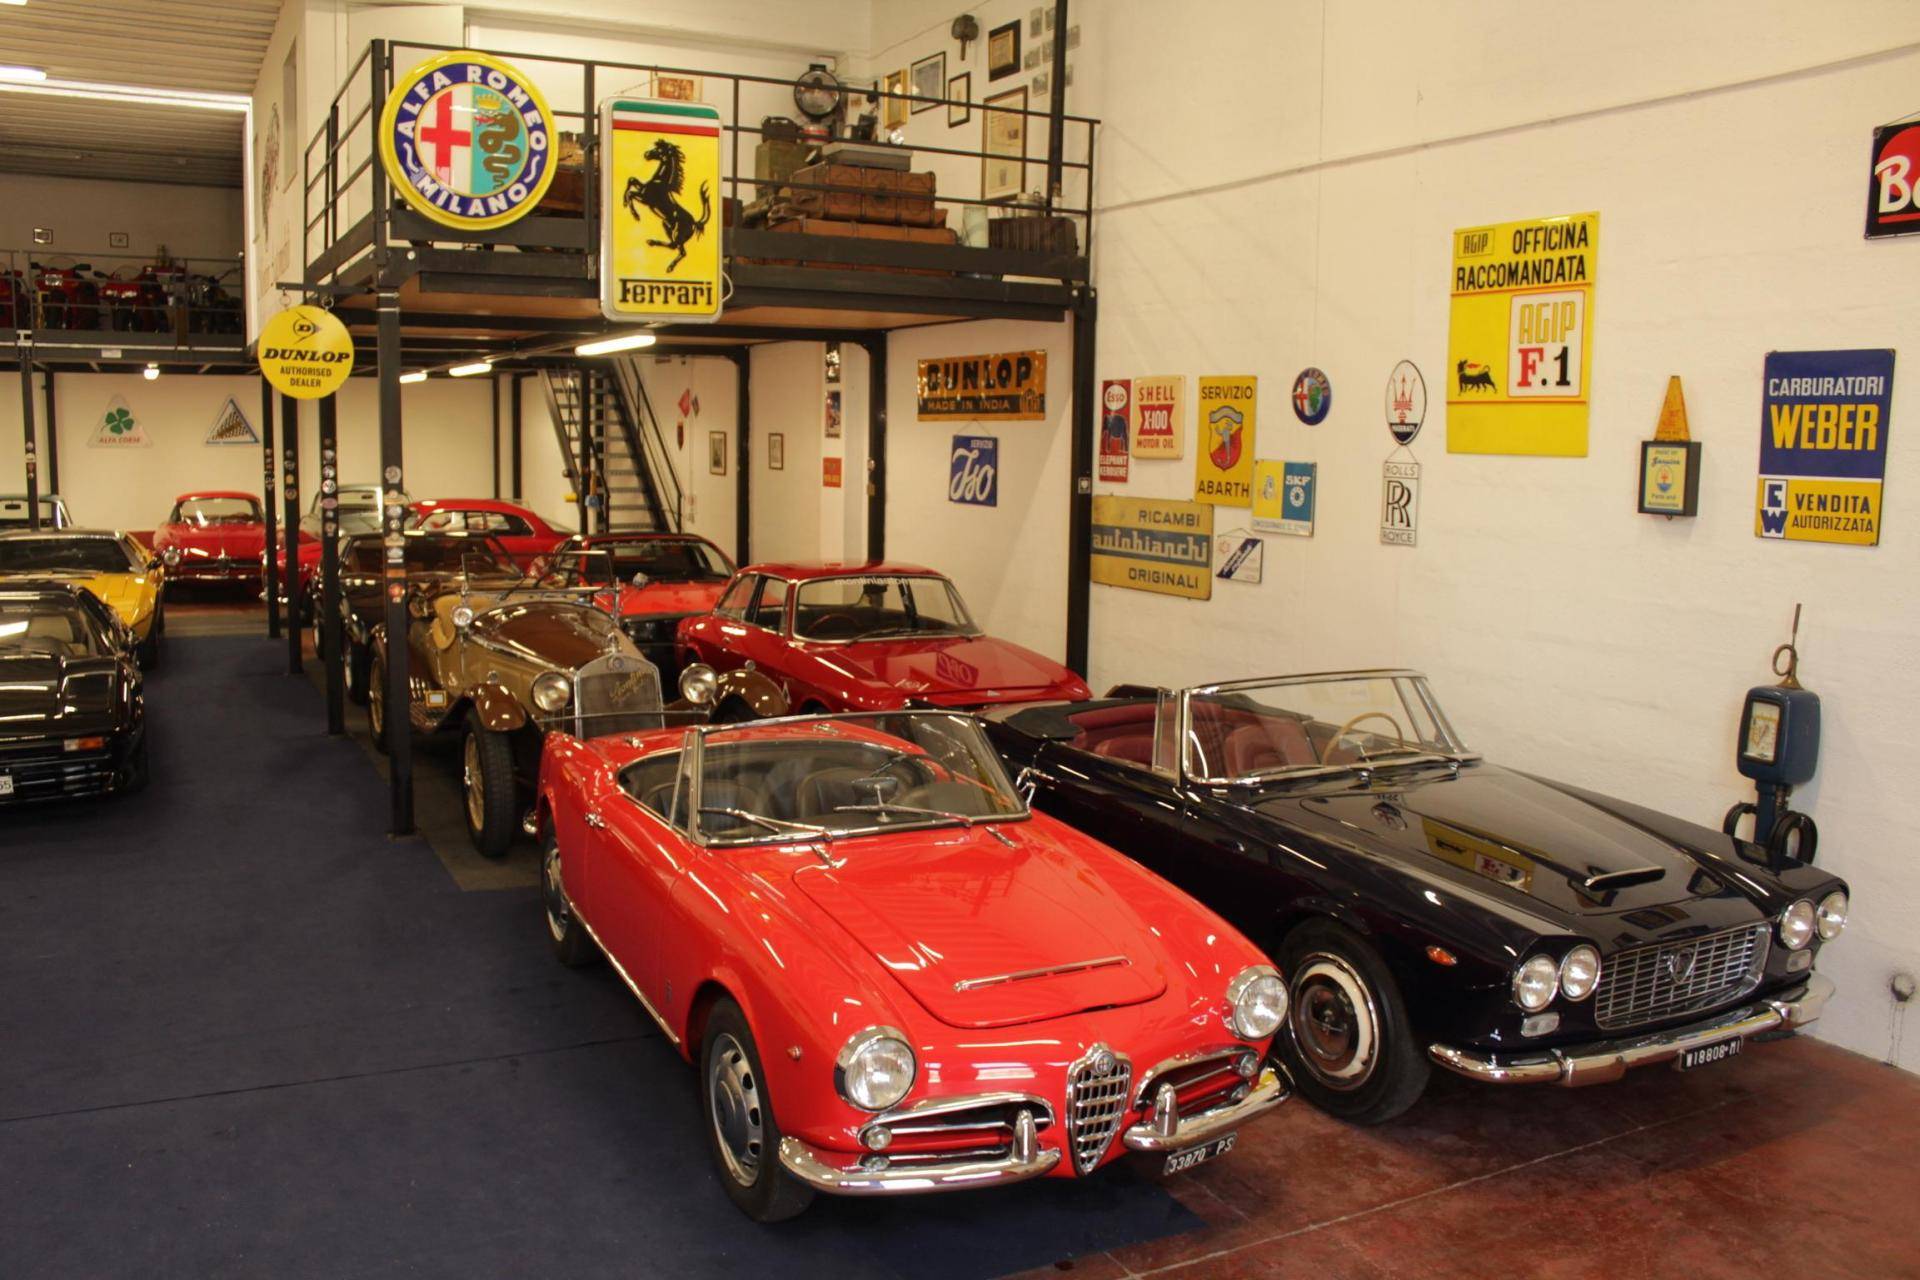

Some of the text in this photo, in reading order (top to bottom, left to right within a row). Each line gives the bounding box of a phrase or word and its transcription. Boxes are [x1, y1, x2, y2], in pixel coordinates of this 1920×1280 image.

[397, 64, 547, 151] ALFA ROMEO
[416, 175, 527, 216] MILANO
[1463, 222, 1589, 254] AGIP OFFICINA
[1456, 254, 1586, 291] RACCOMANDATA
[619, 278, 712, 306] Ferrari
[1518, 301, 1576, 344] AGIP
[263, 348, 351, 363] DUNLOP
[280, 366, 332, 377] AUTHORISED
[927, 357, 1032, 391] DUNLOP
[1517, 345, 1571, 388] F.1
[290, 378, 322, 388] DEALER
[1769, 376, 1885, 396] CARBURATORI
[1107, 391, 1125, 402] Esso
[1138, 385, 1175, 402] SHELL
[1201, 386, 1253, 400] SERVIZIO
[927, 399, 1010, 411] MADE IN INDIA
[1143, 410, 1168, 430] X-100
[1770, 404, 1879, 450] WEBER
[1136, 438, 1174, 449] MOTOR OIL
[1386, 465, 1416, 476] ROLLS
[1198, 480, 1250, 498] ABARTH
[1286, 475, 1311, 486] SKF
[1795, 493, 1871, 514] VENDITA
[1138, 510, 1200, 527] RICAMBI
[1792, 515, 1873, 533] AUTORIZZATA
[1383, 530, 1413, 544] ROYCE
[1128, 567, 1199, 589] ORIGINALI
[1169, 1137, 1234, 1173] 33870 PS
